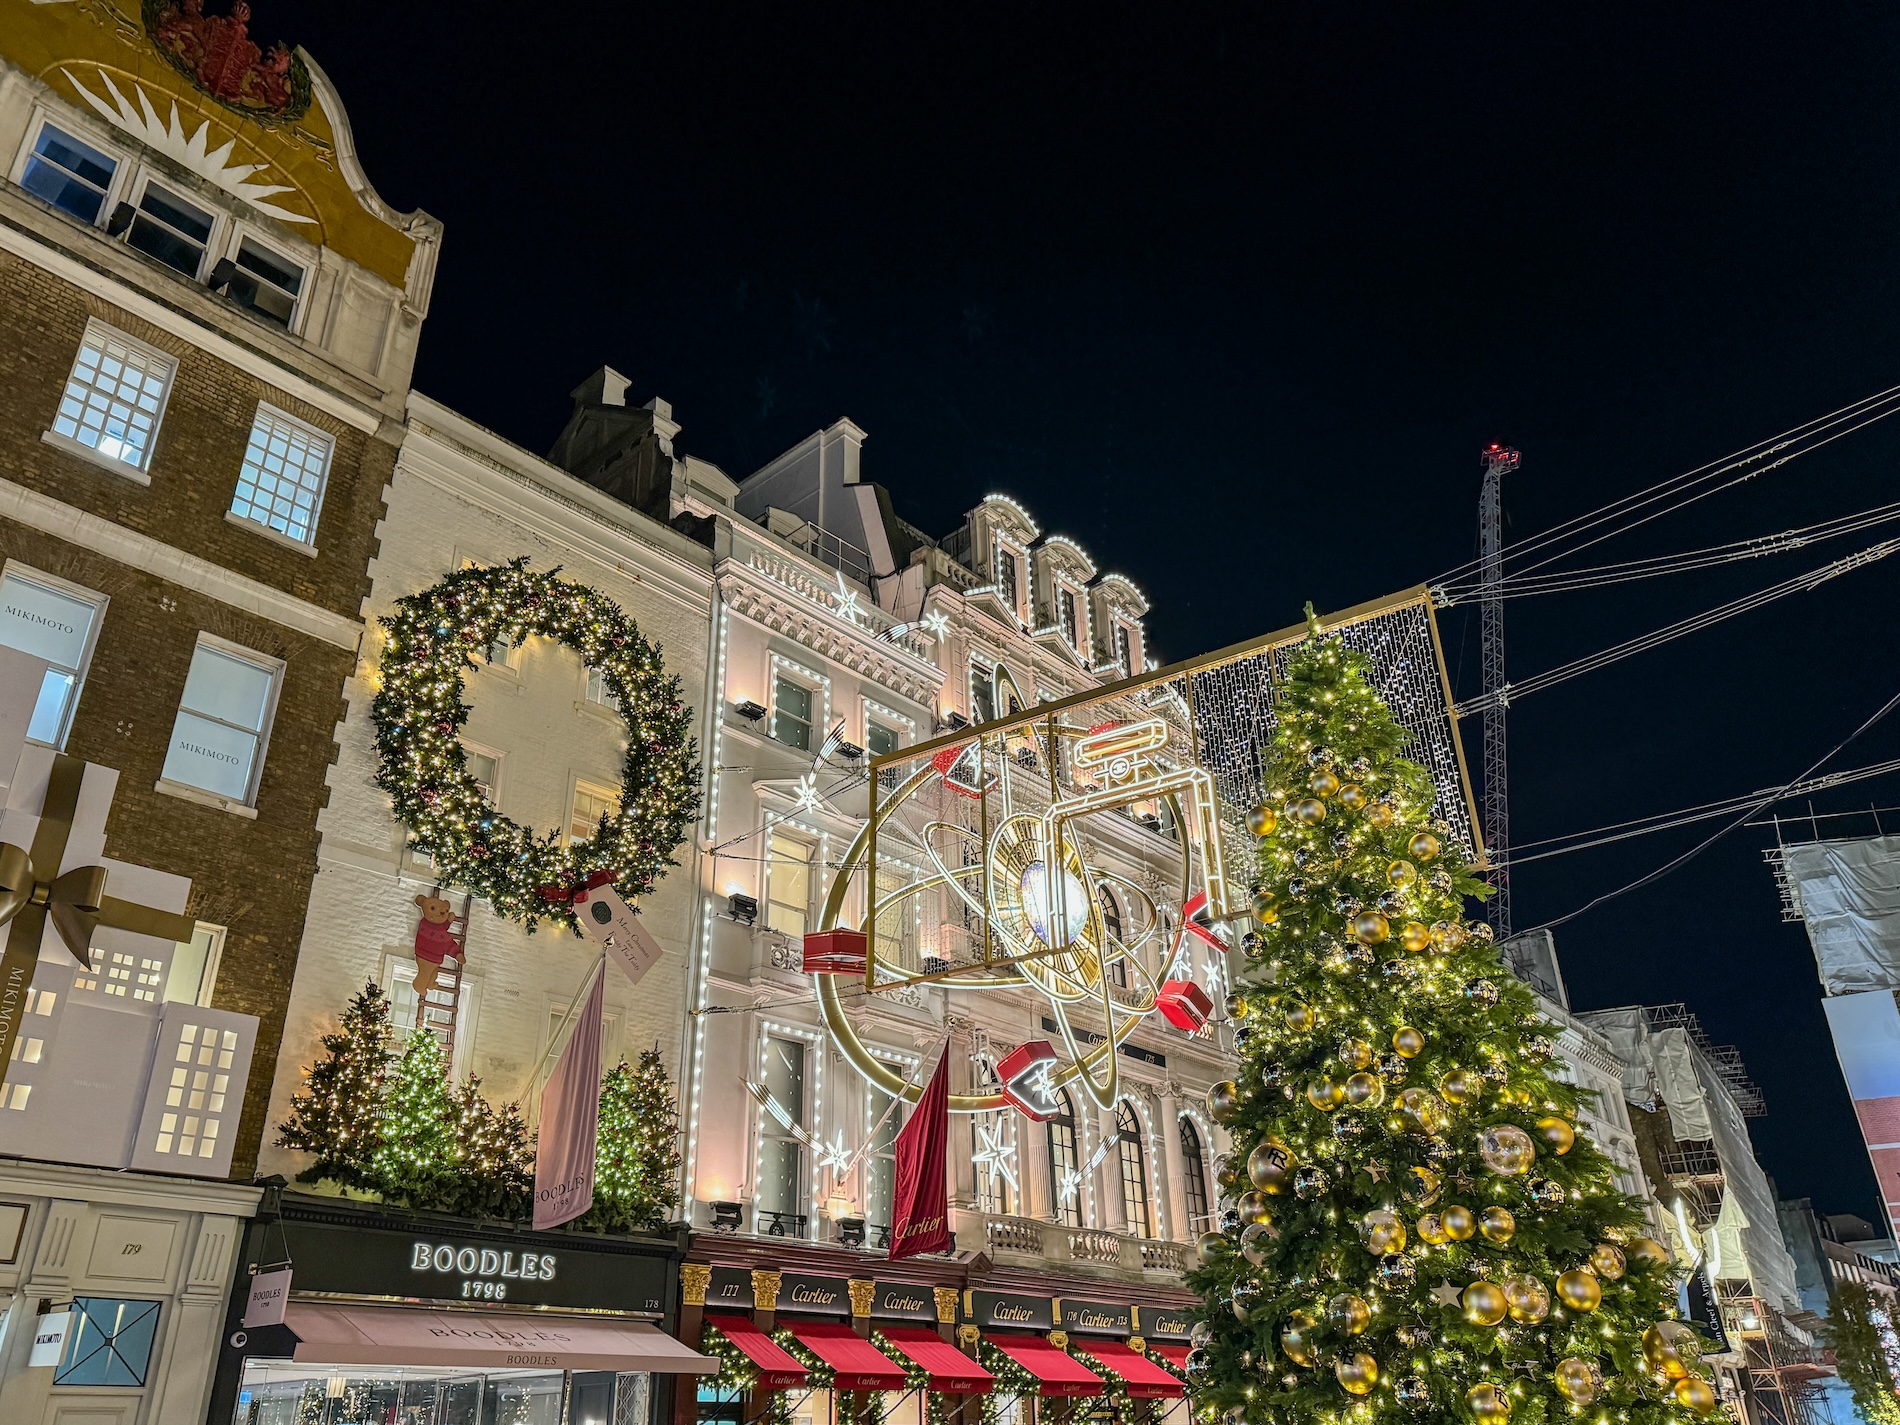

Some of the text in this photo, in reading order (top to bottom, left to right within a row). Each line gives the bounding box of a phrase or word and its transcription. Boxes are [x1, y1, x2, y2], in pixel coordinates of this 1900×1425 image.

[4, 605, 74, 635] MIKIMOTO
[179, 741, 239, 766] MIKIMOTO
[895, 1214, 944, 1242] Cartier
[120, 1243, 144, 1256] 179
[411, 1242, 557, 1281] BOODLES
[461, 1281, 507, 1300] 1798
[720, 1284, 740, 1298] 177
[791, 1283, 837, 1305] Cartier
[1697, 1271, 1711, 1299] Arpels
[252, 1288, 282, 1302] BOODLES
[644, 1299, 660, 1309] 178
[883, 1291, 925, 1312] Cartier
[993, 1301, 1034, 1323] Cartier
[1079, 1308, 1115, 1329] Cartier
[1706, 1308, 1720, 1331] Cleef
[427, 1328, 572, 1342] BOODLES
[1155, 1316, 1187, 1335] Cartier
[506, 1355, 557, 1366] BOODLES
[769, 1373, 797, 1386] Cartier
[857, 1375, 882, 1387] Cartier
[950, 1379, 972, 1390] Cartier
